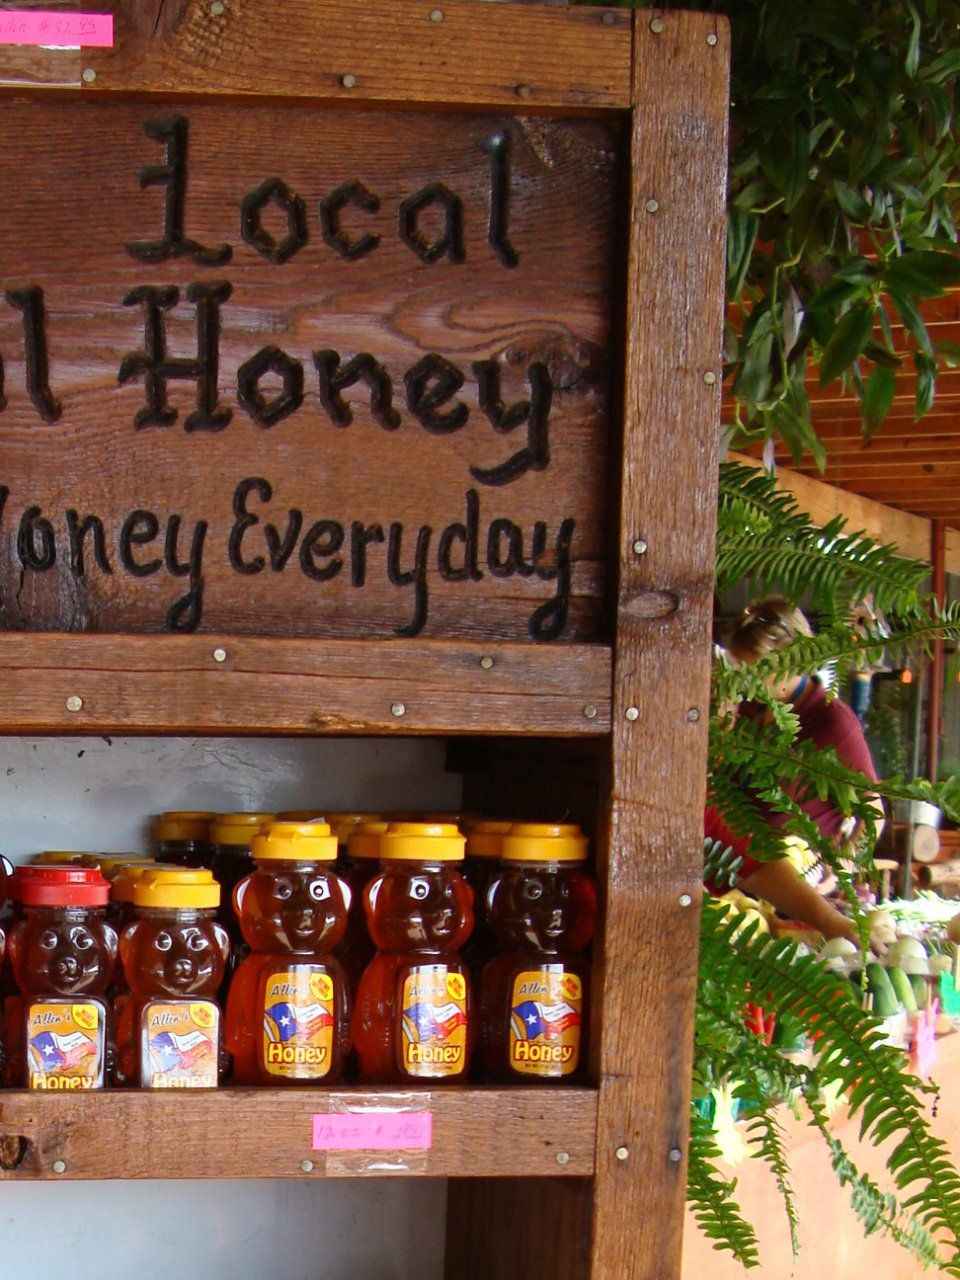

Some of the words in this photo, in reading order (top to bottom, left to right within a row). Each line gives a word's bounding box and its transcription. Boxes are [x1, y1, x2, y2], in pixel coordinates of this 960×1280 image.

[123, 115, 521, 269] Local
[118, 279, 552, 487] Honey
[229, 477, 577, 642] Everyday
[268, 1042, 327, 1064] Honey
[407, 1042, 461, 1064] Honey
[514, 1039, 573, 1062] Honey
[32, 1072, 94, 1089] Honey
